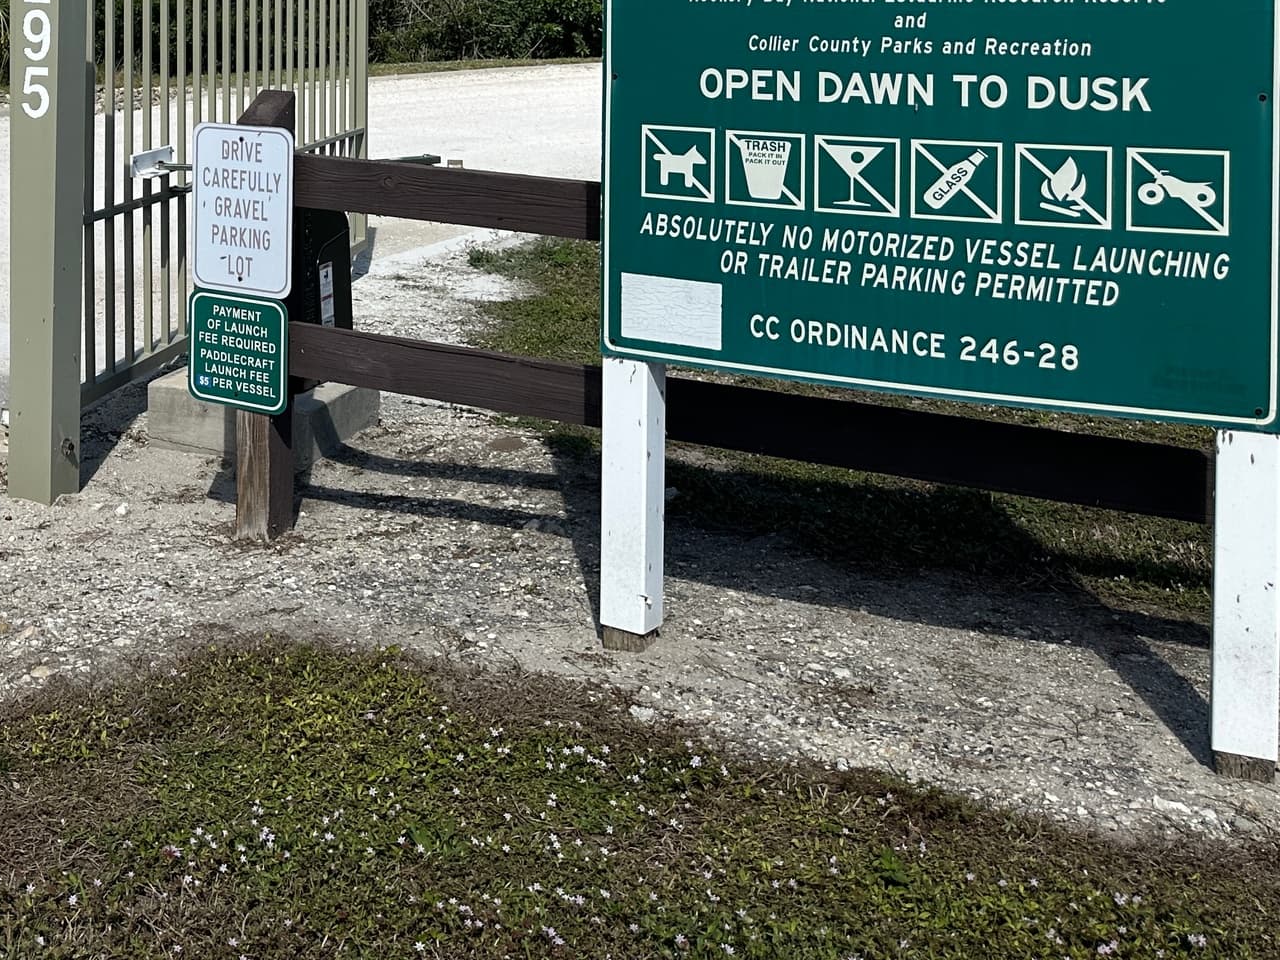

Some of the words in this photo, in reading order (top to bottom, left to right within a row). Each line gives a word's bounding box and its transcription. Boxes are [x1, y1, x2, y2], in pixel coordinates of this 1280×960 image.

[895, 12, 926, 28] and
[749, 35, 799, 51] Collier
[809, 36, 871, 56] County
[881, 37, 932, 54] Parks
[943, 38, 975, 54] and
[985, 38, 1091, 56] Recreation
[700, 68, 800, 101] OPEN
[819, 72, 933, 106] DAWN
[953, 75, 1007, 108] TO
[1028, 76, 1151, 111] DUSK
[222, 140, 262, 163] DRIVE
[745, 140, 786, 152] TRASH
[202, 166, 281, 194] CAREFULLY
[932, 167, 968, 201] GLASS
[214, 196, 268, 222] GRAVEL
[211, 224, 270, 250] PARKING
[640, 213, 774, 246] ABSOLUTELY
[782, 225, 812, 250] NO
[822, 229, 954, 261] MOTORIZED
[966, 239, 1060, 269] VESSEL
[1073, 246, 1229, 279] LAUNCHING
[228, 256, 253, 277] LOT
[721, 250, 747, 274] OR
[759, 254, 851, 285] TRAILER
[861, 263, 965, 295] PARKING
[975, 272, 1119, 306] PERMITTED
[213, 305, 261, 322] PAYMENT
[208, 319, 221, 330] OF
[225, 321, 267, 338] LAUNCH
[199, 331, 218, 344] FEE
[222, 335, 275, 353] REQUIRED
[751, 315, 779, 339] CC
[791, 319, 945, 358] ORDINANCE
[960, 336, 1078, 370] 246-28
[200, 348, 275, 371] PADDLECRAFT
[205, 362, 246, 379] LAUNCH
[250, 371, 269, 383] FEE
[213, 377, 232, 390] PER
[236, 381, 276, 398] VESSEL
